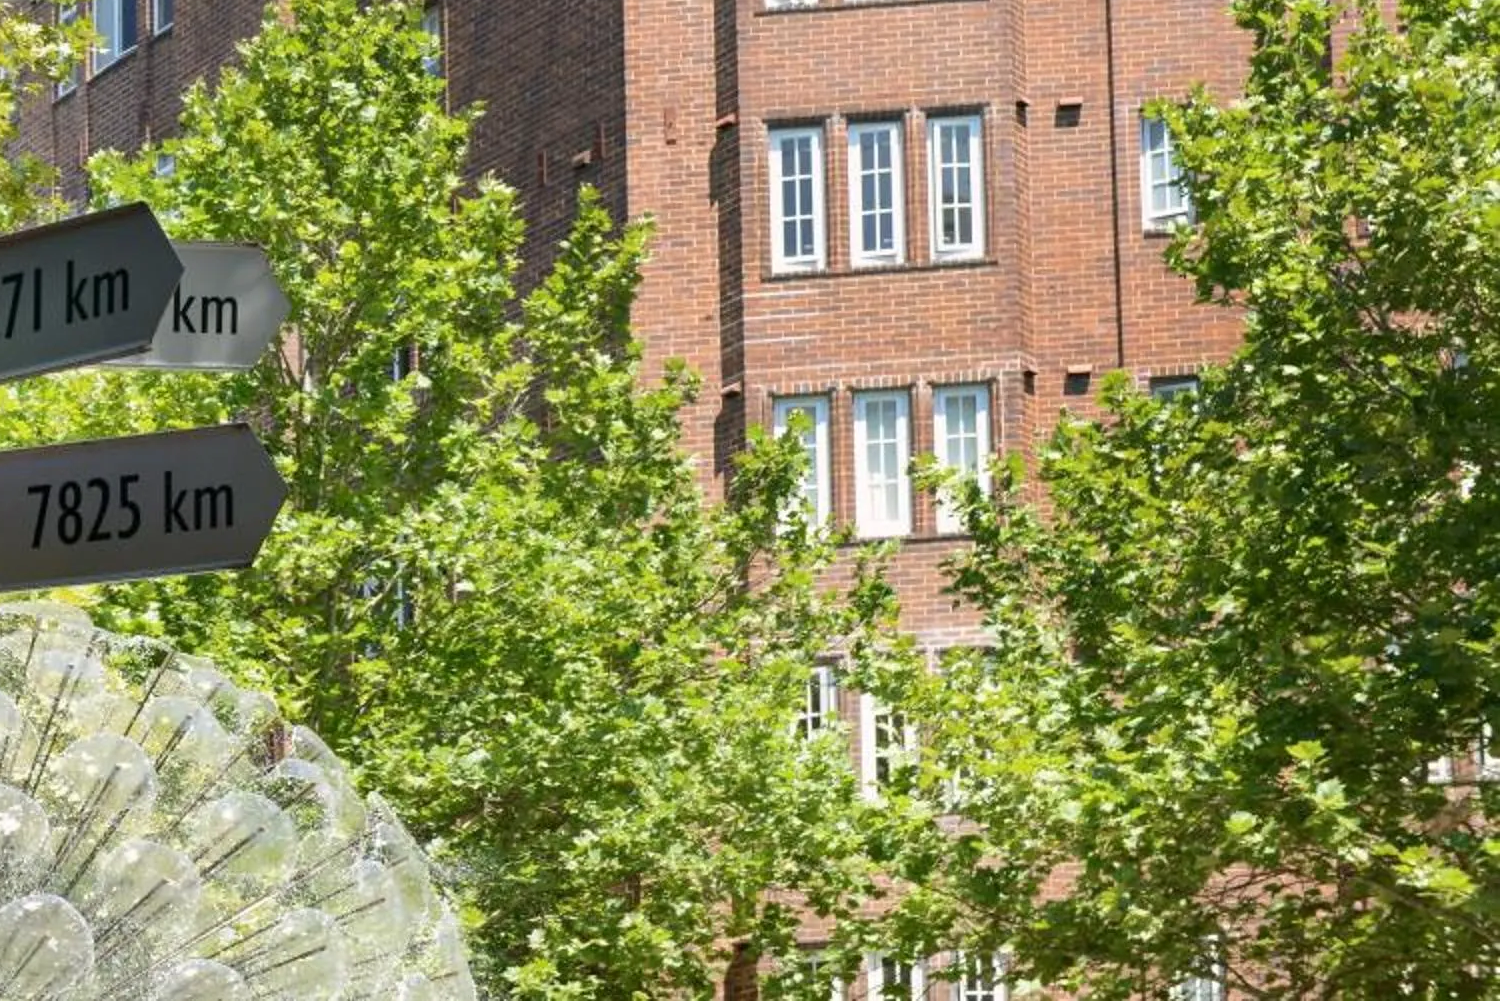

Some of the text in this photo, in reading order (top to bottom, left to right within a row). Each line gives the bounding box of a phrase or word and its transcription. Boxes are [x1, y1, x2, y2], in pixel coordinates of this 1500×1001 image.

[65, 259, 130, 324] km
[173, 283, 238, 335] km
[27, 473, 142, 549] 7825
[163, 470, 234, 534] km
